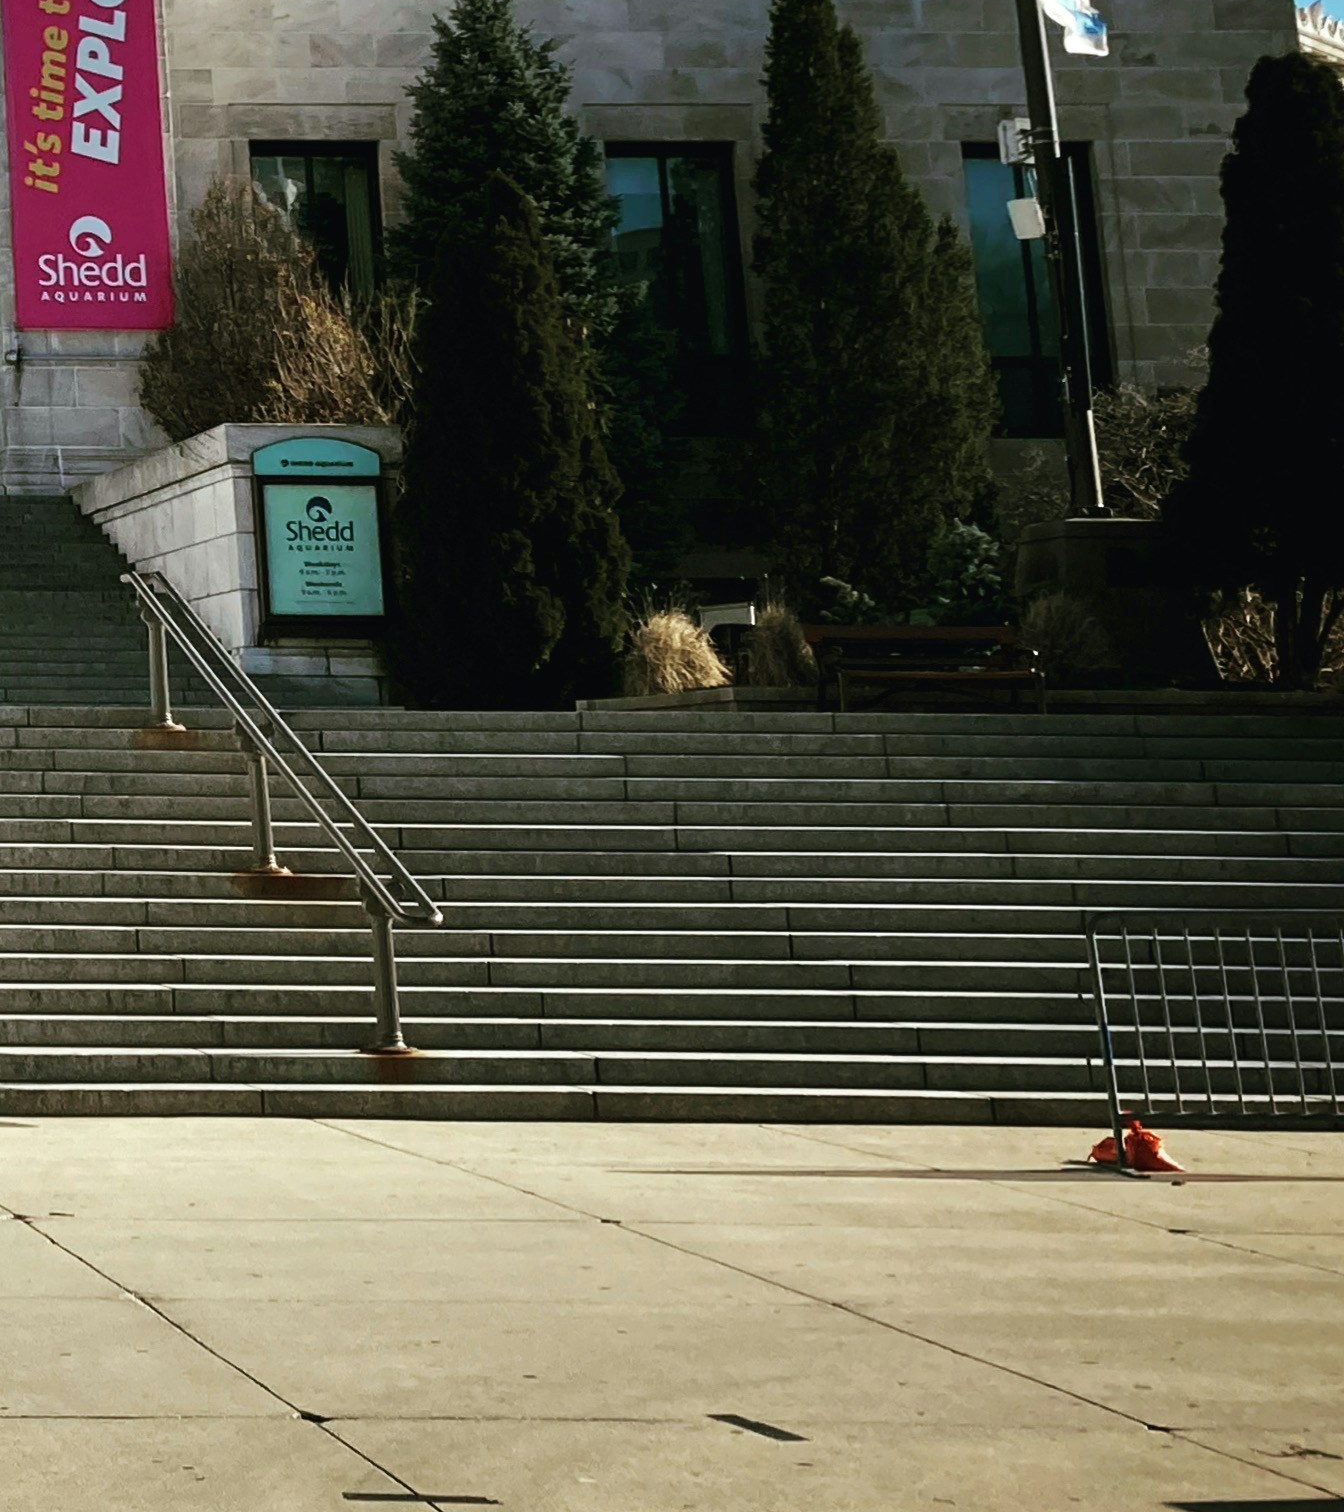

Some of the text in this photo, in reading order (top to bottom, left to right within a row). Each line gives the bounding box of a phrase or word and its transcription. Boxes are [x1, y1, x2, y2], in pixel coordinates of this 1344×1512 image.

[30, 24, 70, 123] time
[25, 127, 63, 194] it's
[38, 253, 147, 288] Shedd
[41, 291, 147, 302] AQUARIUM
[286, 520, 354, 542] Shedd
[288, 544, 354, 552] AQUARIUM
